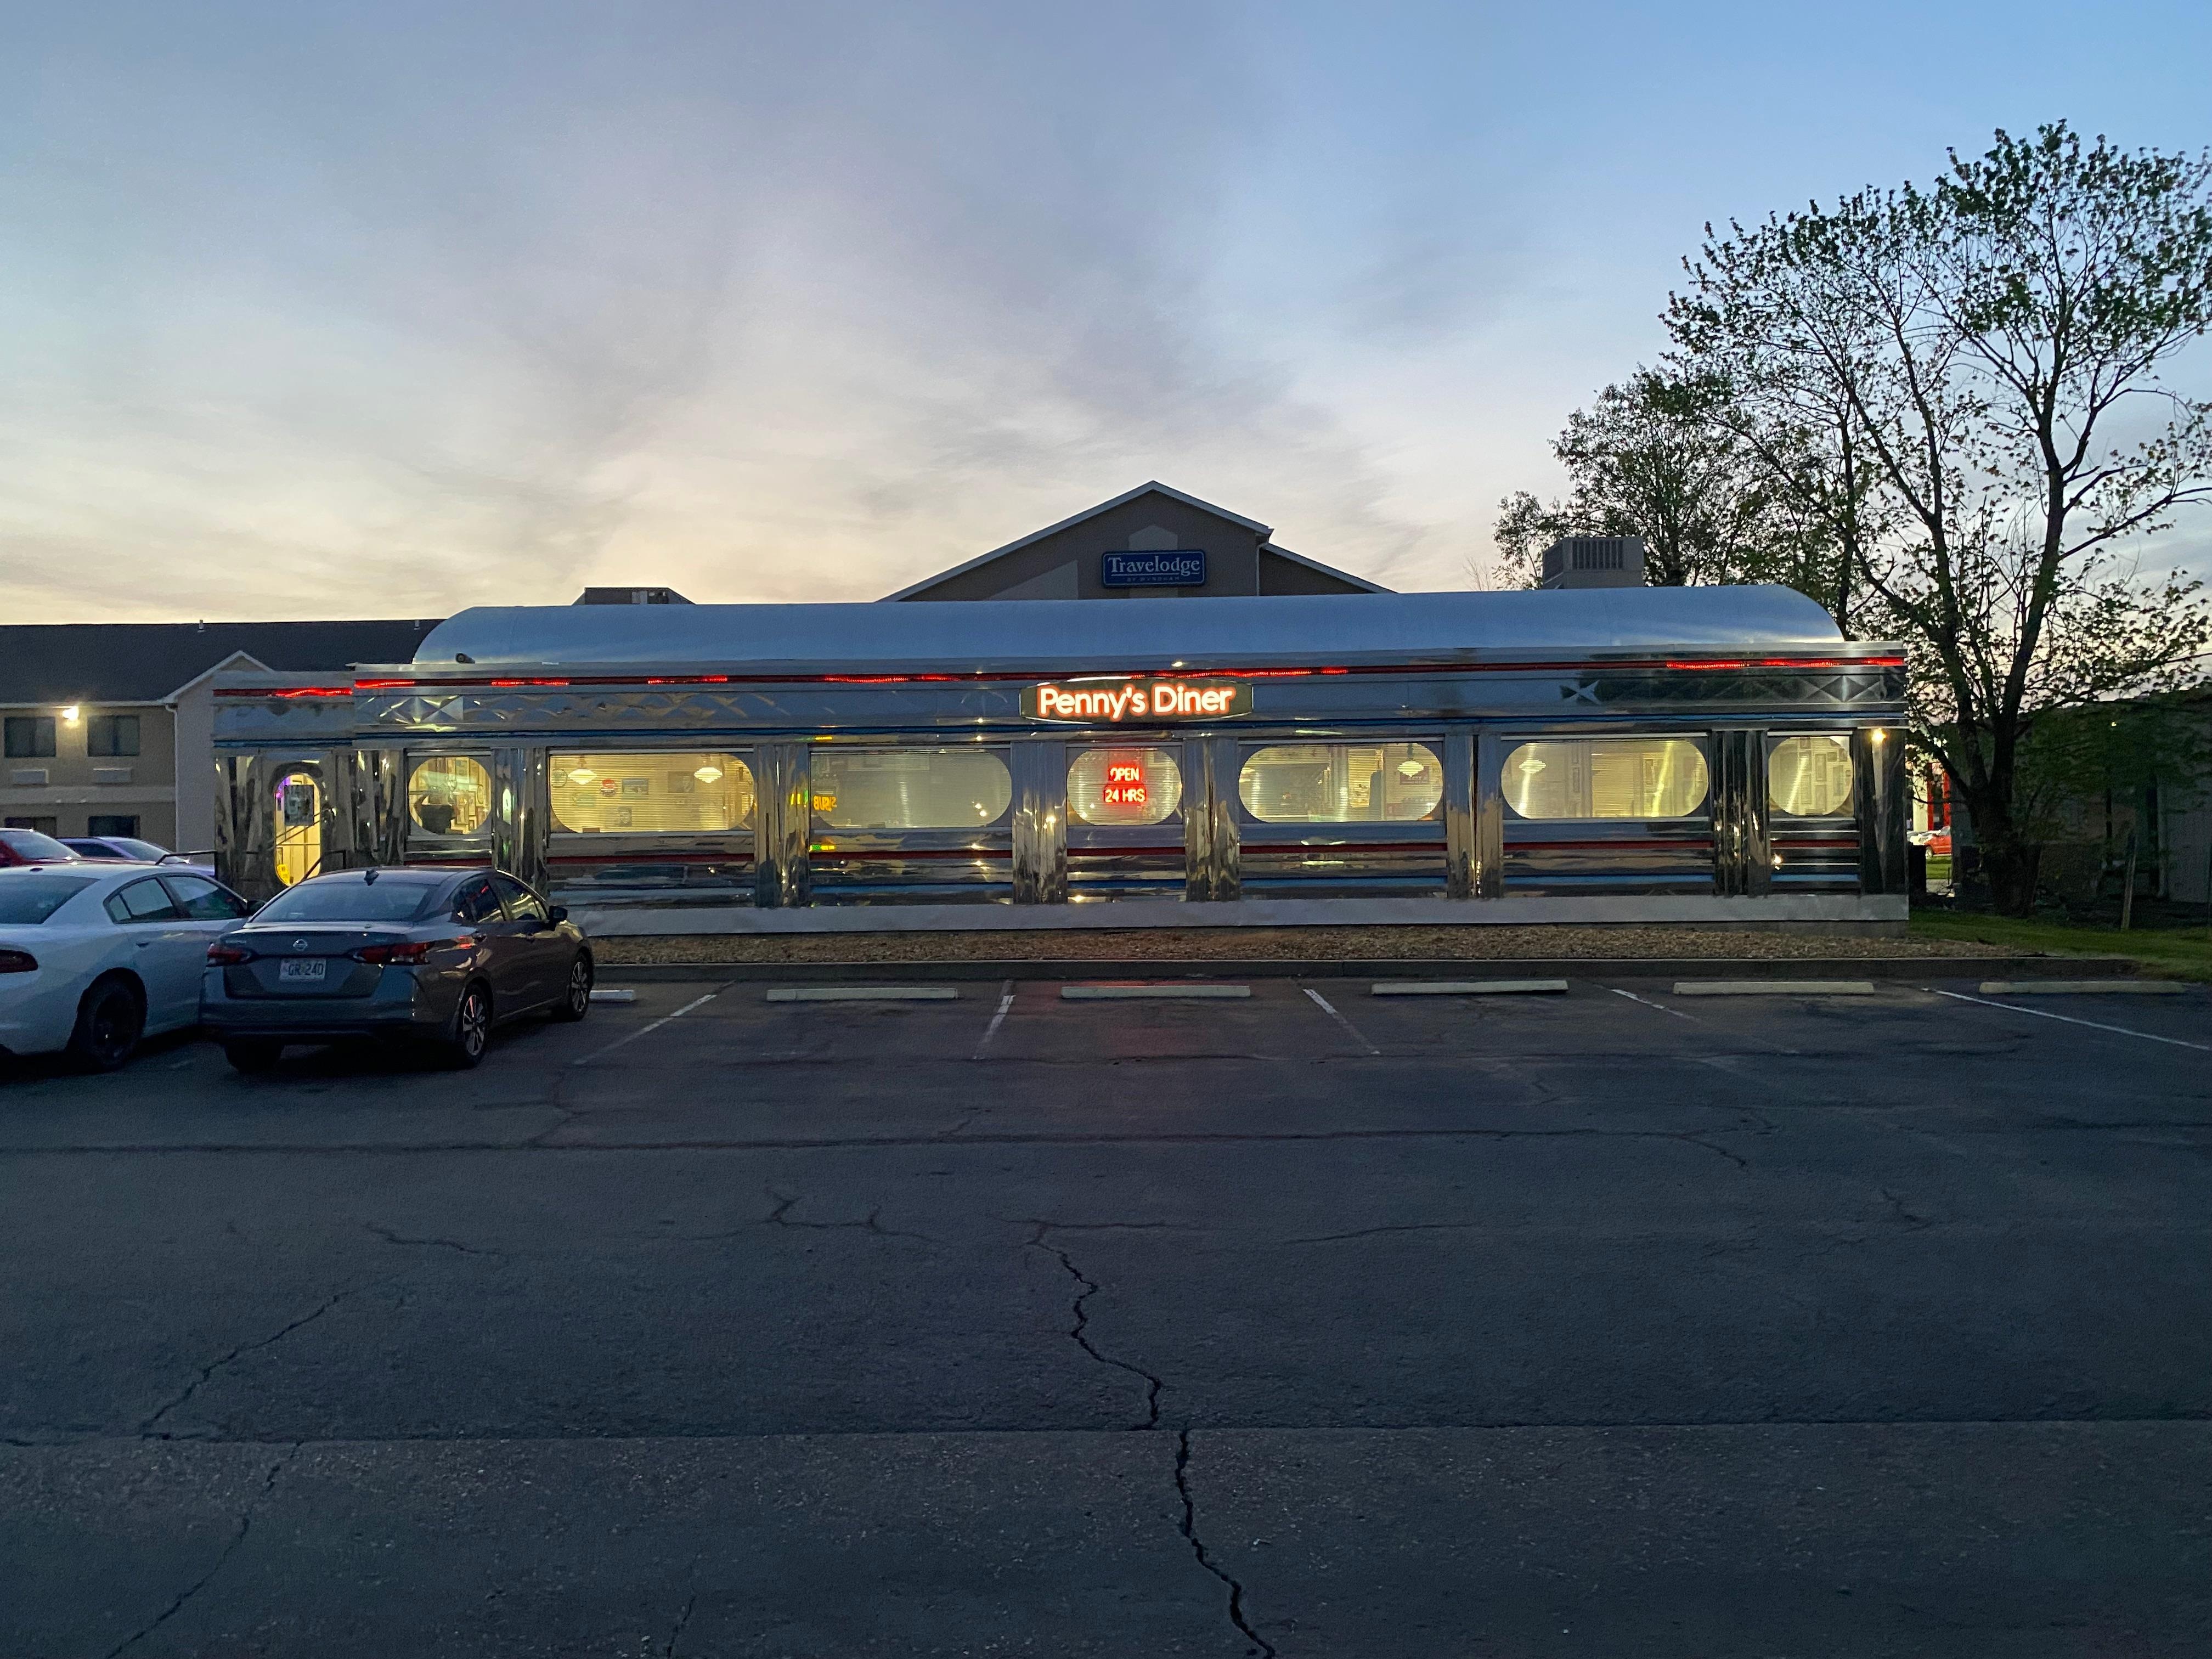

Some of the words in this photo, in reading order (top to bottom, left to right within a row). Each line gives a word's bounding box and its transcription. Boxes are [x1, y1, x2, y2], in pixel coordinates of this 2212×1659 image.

[1107, 555, 1200, 576] Travelodge
[1040, 686, 1147, 720] Penny's
[1153, 685, 1234, 713] Diner
[1109, 767, 1139, 782] OPEN
[1104, 788, 1119, 803] 24
[1122, 788, 1146, 803] HRS
